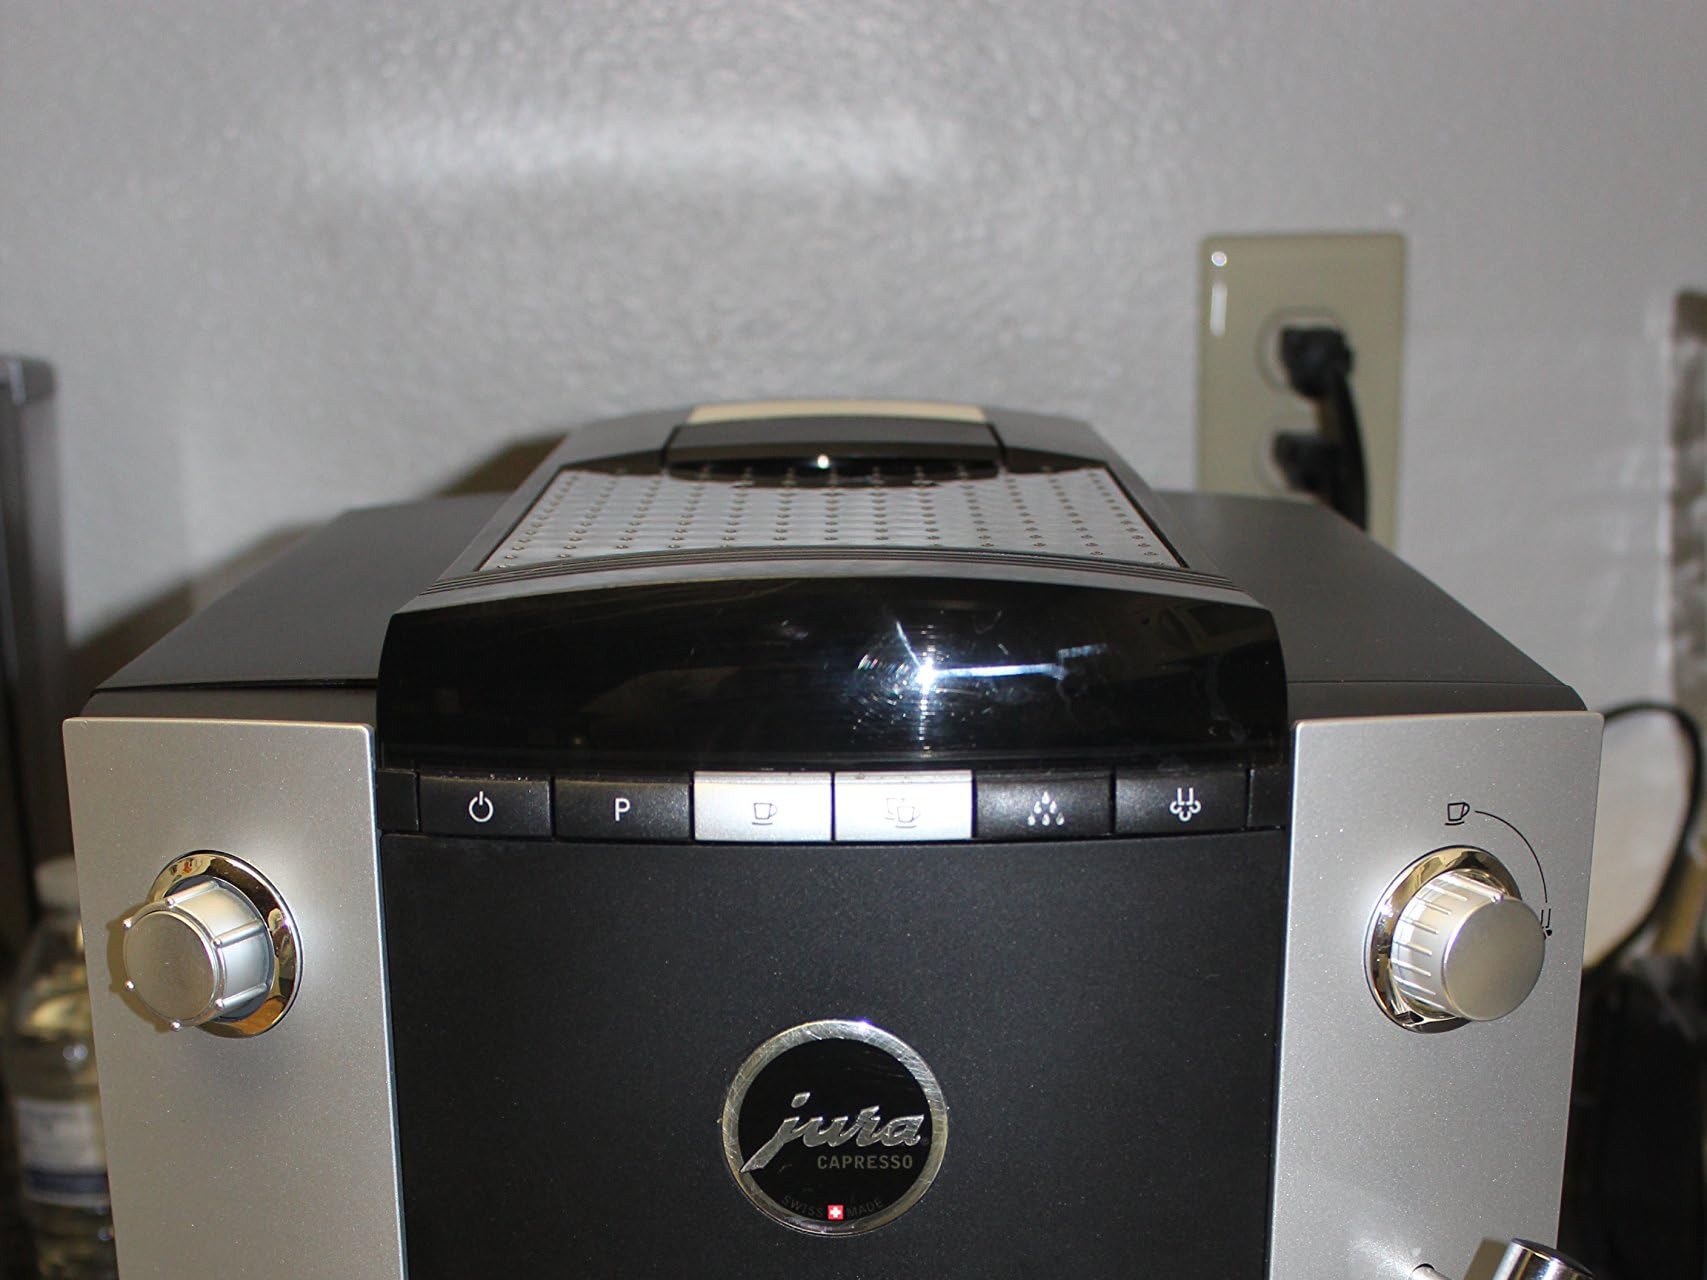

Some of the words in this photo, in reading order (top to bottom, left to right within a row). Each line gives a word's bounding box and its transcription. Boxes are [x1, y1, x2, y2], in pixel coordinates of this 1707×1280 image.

[615, 797, 630, 821] P
[740, 1092, 924, 1173] jura
[817, 1155, 913, 1169] CAPRESSO
[782, 1194, 823, 1218] SWISS
[847, 1197, 884, 1217] MADE
